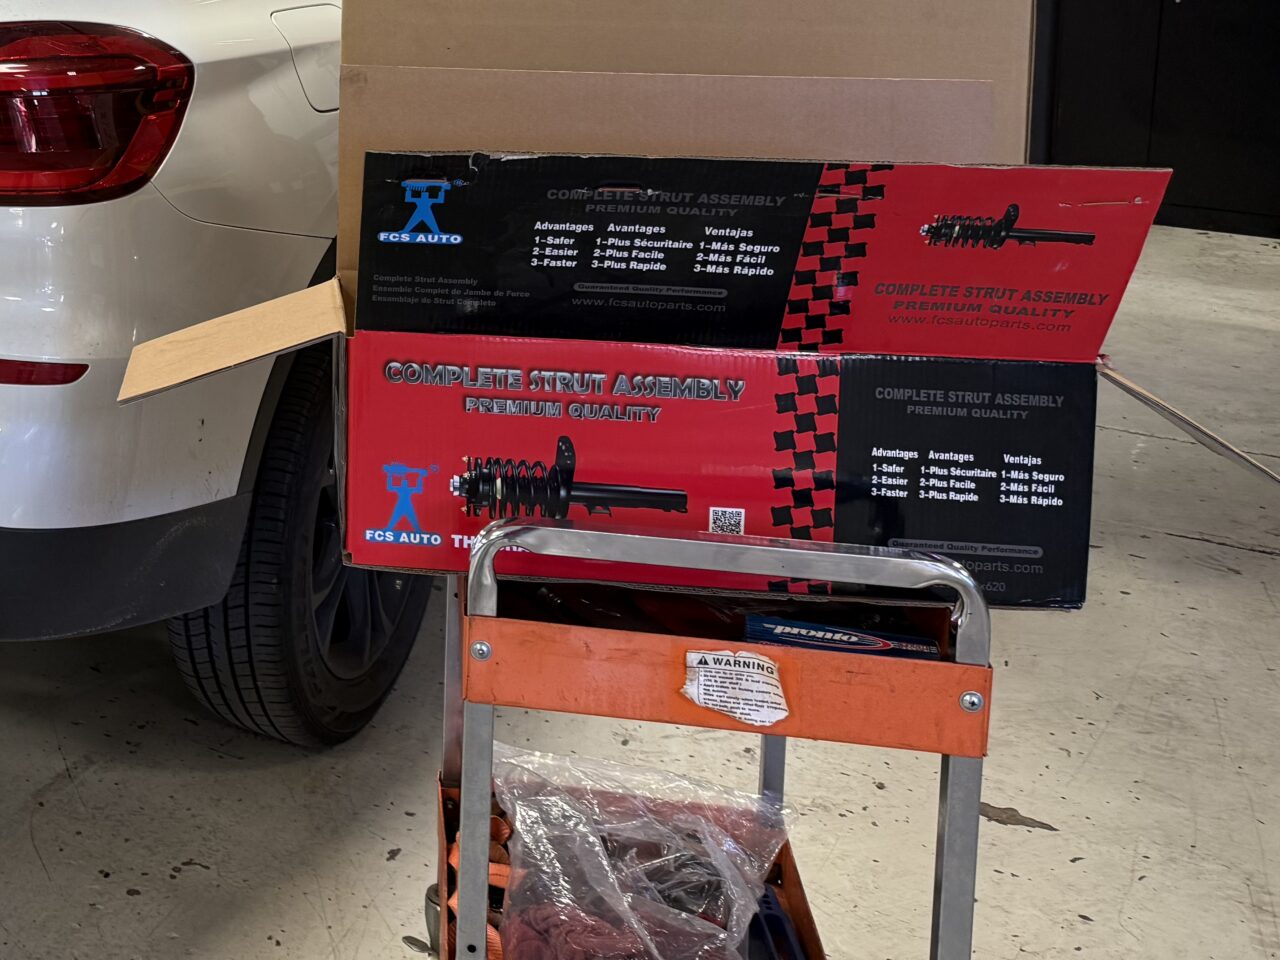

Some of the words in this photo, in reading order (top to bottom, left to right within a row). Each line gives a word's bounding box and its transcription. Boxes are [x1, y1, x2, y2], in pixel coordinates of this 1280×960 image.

[546, 189, 634, 201] COMPLETE
[637, 190, 694, 204] STRUT
[697, 193, 786, 206] ASSEMBLY
[585, 204, 661, 214] PREMIUM
[666, 206, 738, 216] QUALITY
[534, 221, 594, 233] Advantages
[607, 223, 666, 234] Avantages
[704, 226, 754, 238] Ventajas
[379, 232, 410, 243] FCS
[415, 233, 462, 244] AUTO
[534, 235, 575, 245] 1-Safer
[596, 238, 631, 247] 1-Plus
[633, 238, 694, 249] Sécuritaire
[532, 247, 579, 256] 2-Easier
[699, 241, 735, 251] 1-Más
[738, 243, 780, 253] Seguro
[593, 249, 629, 258] 2-Plus
[631, 250, 665, 259] Facile
[696, 253, 732, 262] 2-Más
[736, 254, 766, 264] Fácil
[530, 258, 578, 268] 3-Faster
[591, 260, 627, 269] 3-Plus
[629, 261, 667, 272] Rapide
[693, 264, 730, 274] 3-Más
[733, 265, 775, 276] Rápido
[373, 274, 413, 283] Complete
[414, 275, 436, 283] Strut
[438, 276, 479, 286] Assembly
[874, 282, 960, 297] COMPLETE
[963, 286, 1018, 301] STRUT
[1021, 290, 1109, 306] ASSEMBLY
[433, 297, 455, 305] Strut
[571, 297, 726, 312] www.fcsautoparts.com
[892, 300, 982, 312] PREMIUM
[989, 304, 1075, 319] QUALITY
[888, 314, 1071, 332] www.fcsautoparts.com
[385, 362, 523, 391] COMPLETE
[529, 370, 607, 396] STRUT
[613, 374, 746, 402] ASSEMBLY
[875, 387, 944, 402] COMPLETE
[948, 391, 991, 404] STRUT
[994, 393, 1064, 408] ASSEMBLY
[465, 397, 562, 418] PREMIUM
[568, 401, 662, 423] QUALITY
[907, 405, 967, 417] PREMIUM
[971, 408, 1029, 420] QUALITY
[871, 447, 918, 460] Advantages
[928, 450, 974, 462] Avantages
[1003, 454, 1042, 466] Ventajas
[872, 463, 905, 473] 1-Safer
[920, 466, 948, 475] 1-Plus
[950, 467, 997, 478] Sécuritaire
[871, 476, 908, 486] 2-Easier
[1031, 472, 1065, 482] Seguro
[919, 478, 948, 488] 2-Plus
[949, 479, 976, 489] Facile
[1031, 484, 1055, 494] Fácil
[871, 488, 908, 498] 3-Faster
[919, 490, 947, 500] 3-Plus
[949, 491, 979, 503] Rapide
[1031, 495, 1063, 507] Rápido
[365, 530, 394, 542] FCS
[399, 532, 441, 545] AUTO
[947, 543, 979, 553] Quality
[981, 546, 1039, 556] Performance
[773, 624, 859, 642] pronto
[712, 656, 775, 675] WARNING
